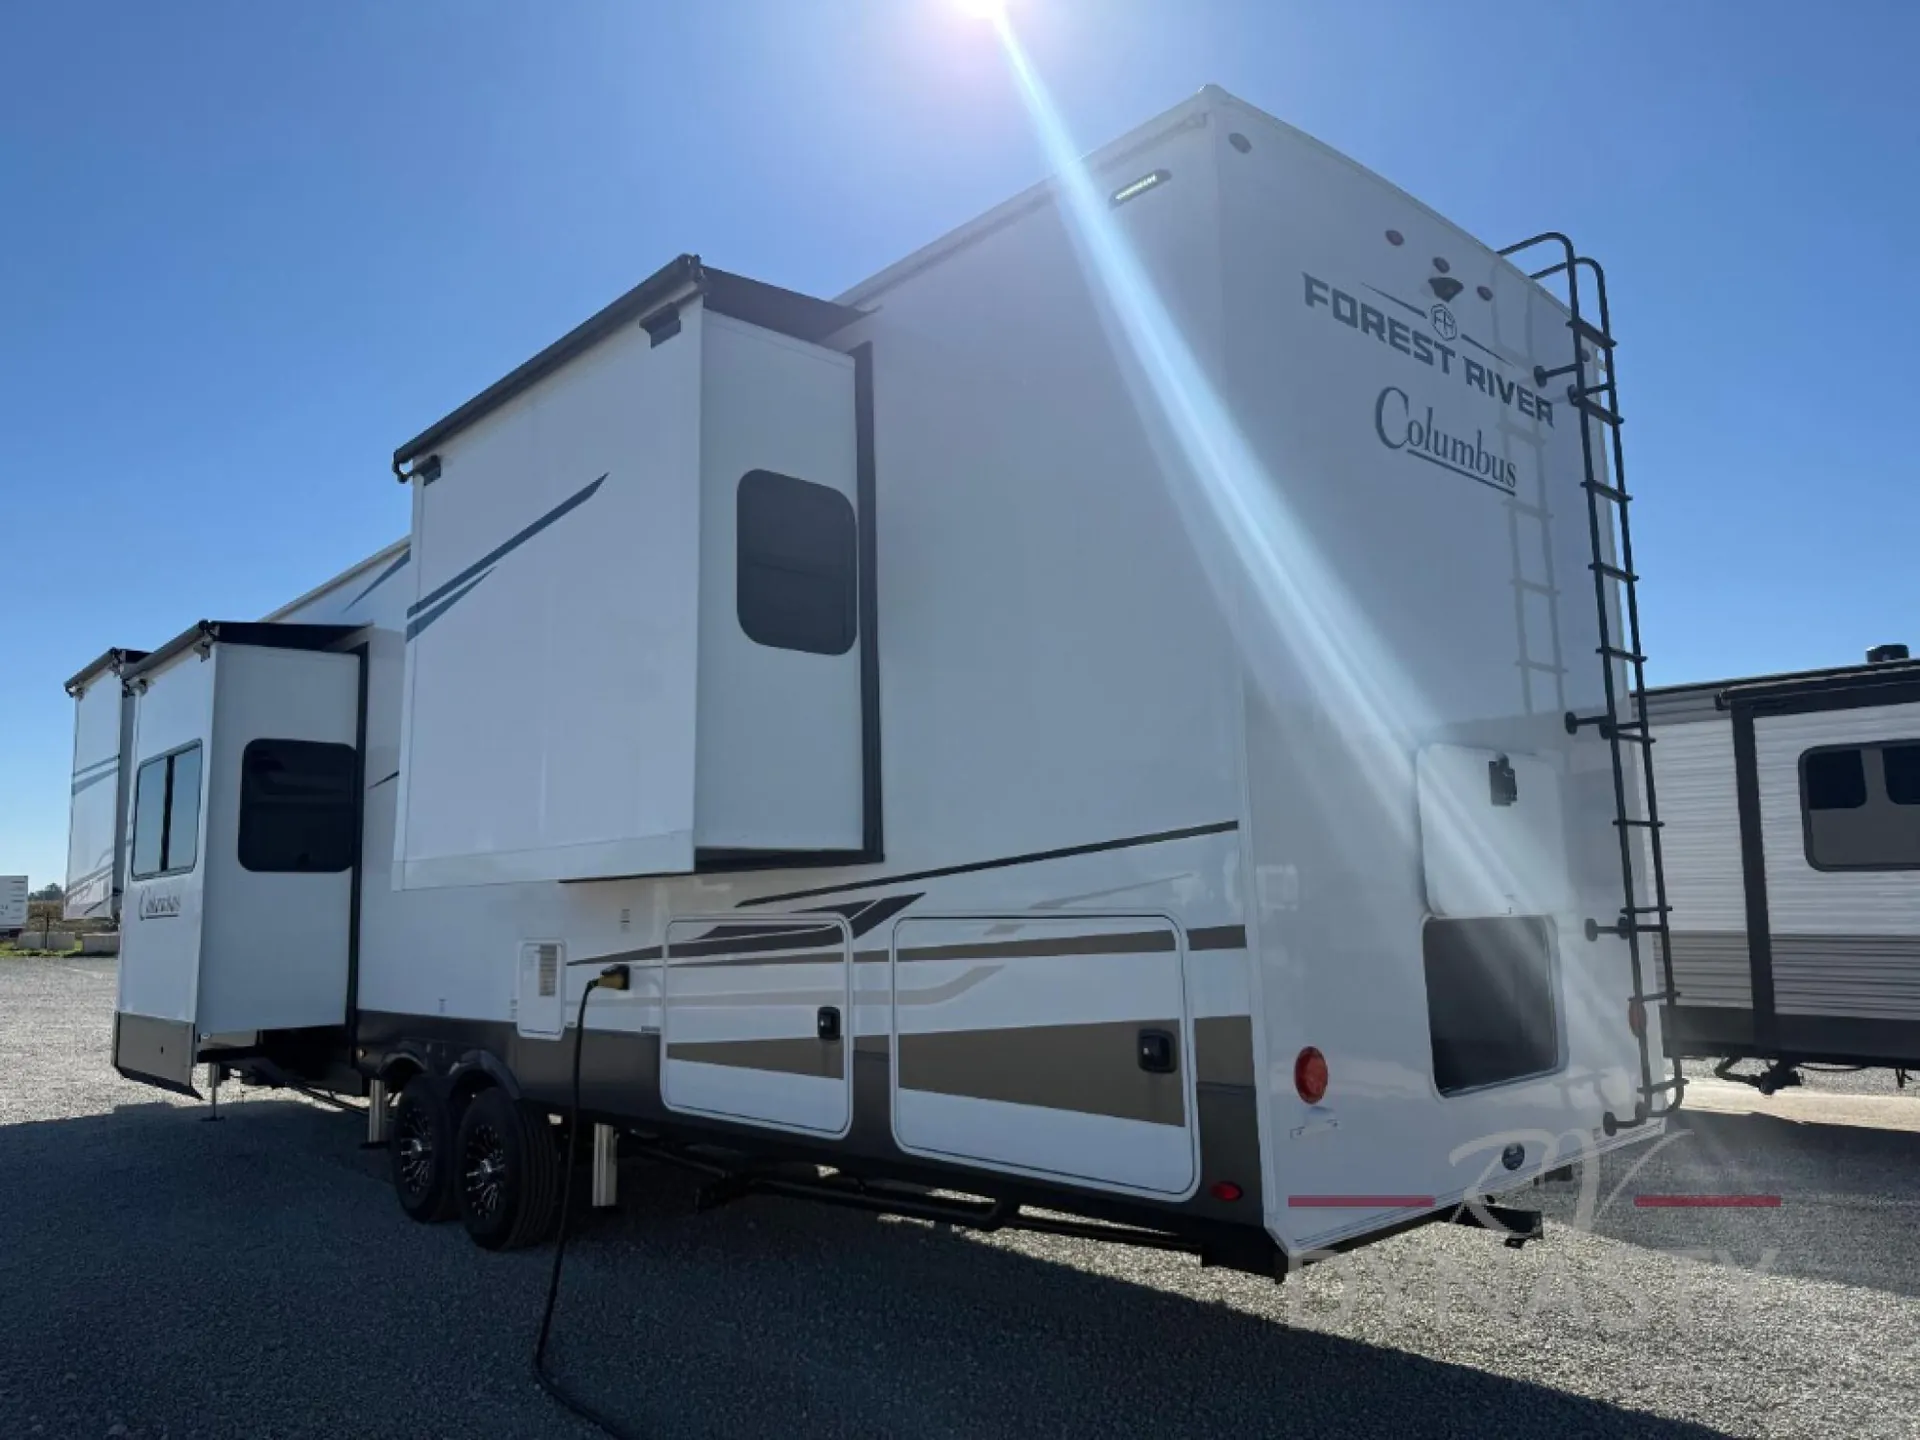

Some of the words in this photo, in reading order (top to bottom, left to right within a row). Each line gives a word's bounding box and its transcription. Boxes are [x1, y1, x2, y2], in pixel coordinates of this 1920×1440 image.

[1302, 272, 1456, 376] FOREST
[1463, 355, 1555, 428] RIVER
[1375, 386, 1517, 488] Columbus
